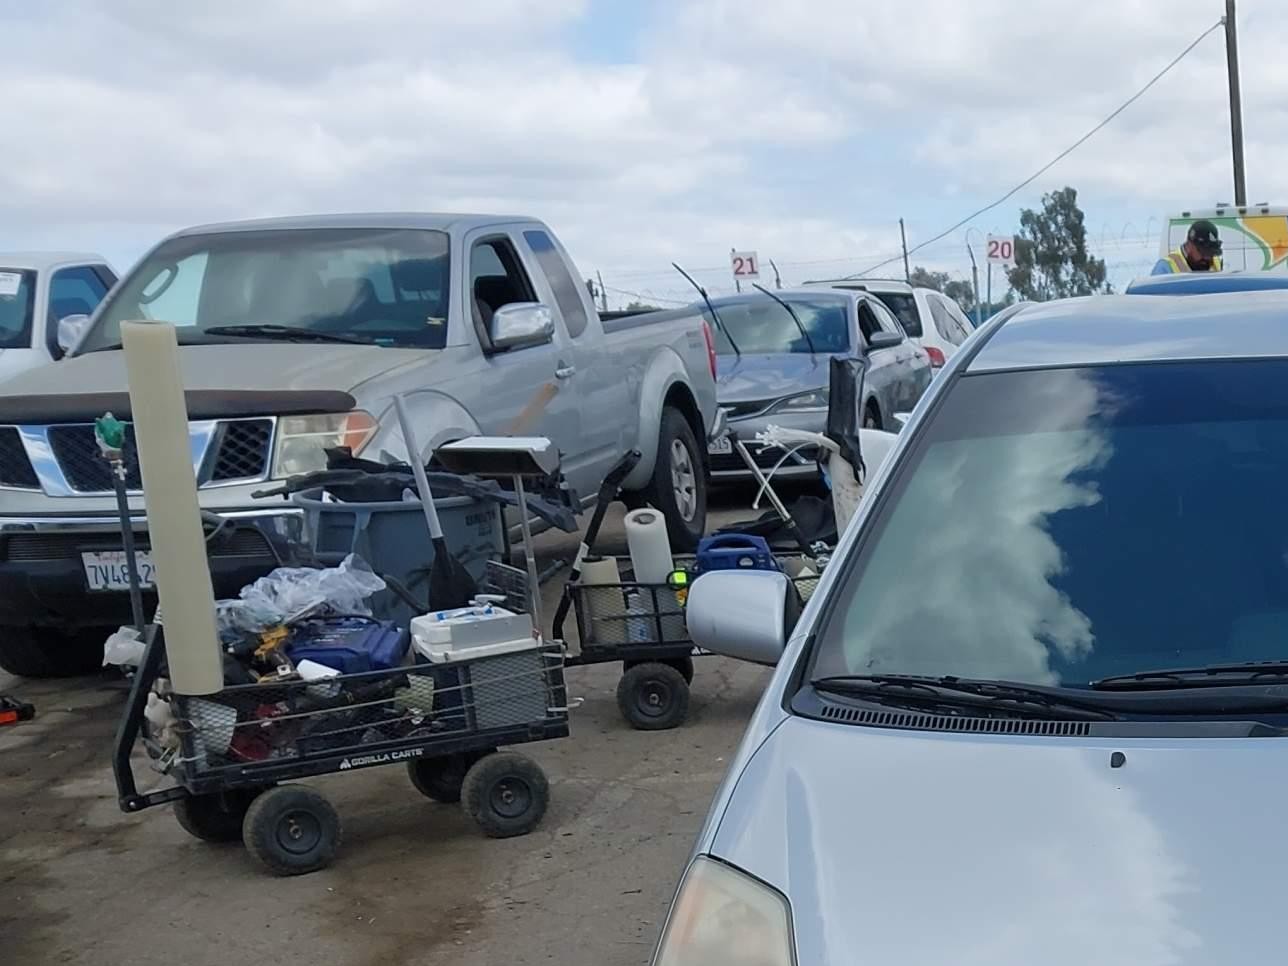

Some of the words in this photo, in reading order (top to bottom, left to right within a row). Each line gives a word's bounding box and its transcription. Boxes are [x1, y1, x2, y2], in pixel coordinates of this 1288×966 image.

[988, 240, 1012, 259] 20
[733, 257, 758, 275] 21
[351, 754, 391, 766] GORILLA
[391, 748, 423, 760] CARTS
